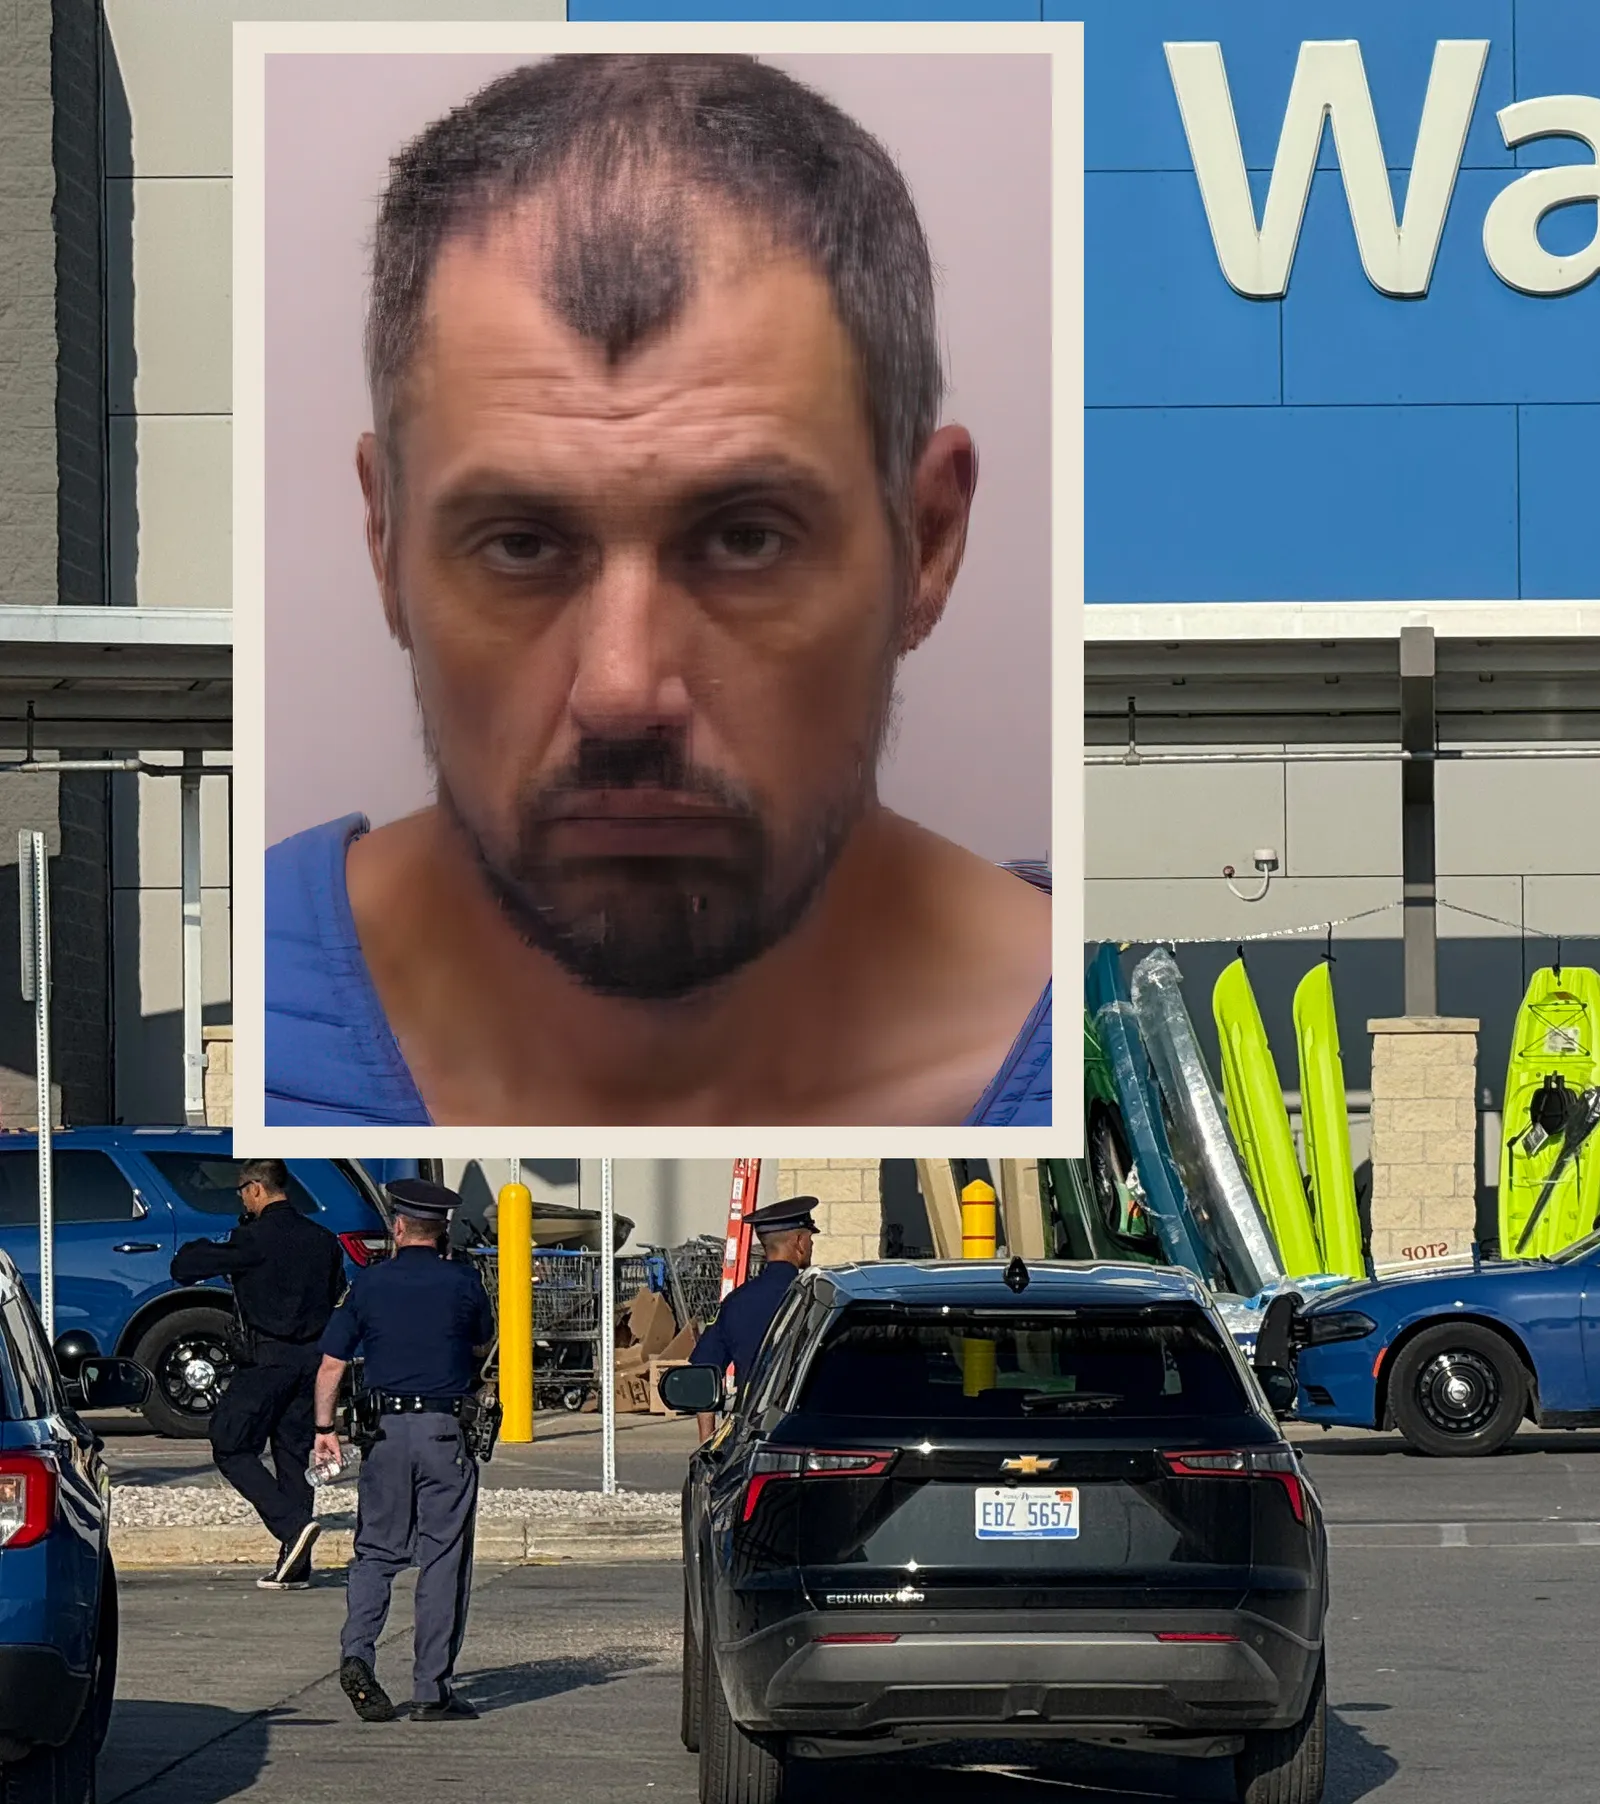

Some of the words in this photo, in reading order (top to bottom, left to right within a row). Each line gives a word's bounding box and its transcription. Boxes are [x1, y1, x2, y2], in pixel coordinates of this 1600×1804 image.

[982, 1502, 1015, 1527] EBZ
[1028, 1502, 1072, 1527] 5657
[826, 1594, 895, 1604] EQUINOX
